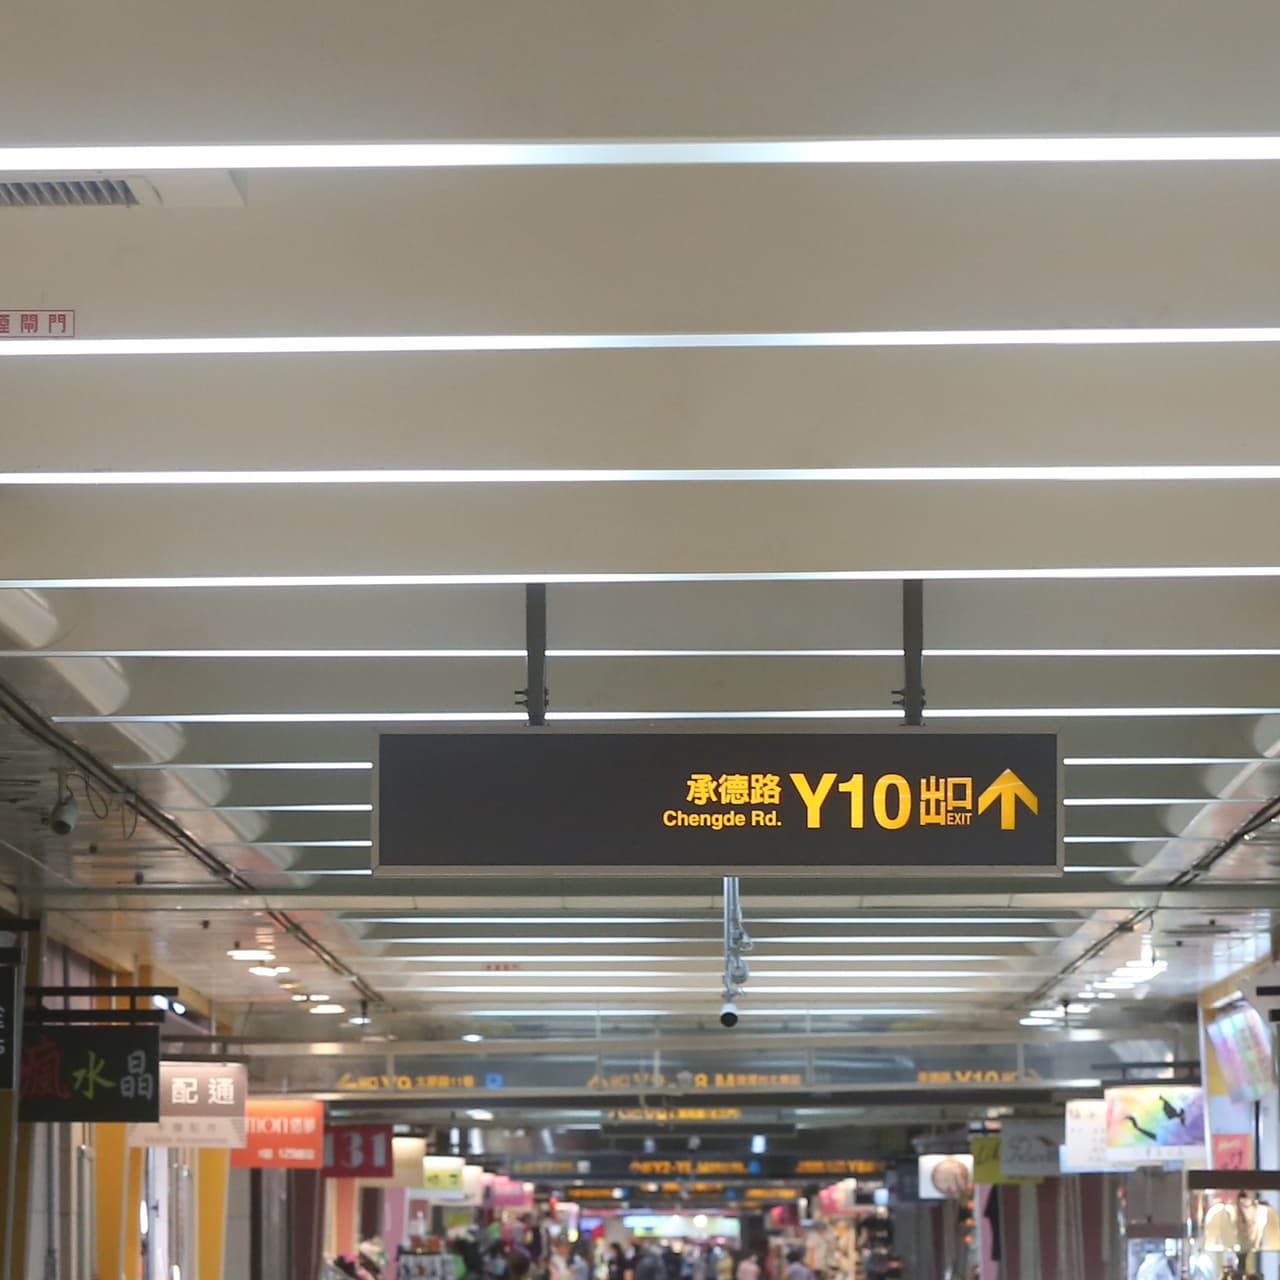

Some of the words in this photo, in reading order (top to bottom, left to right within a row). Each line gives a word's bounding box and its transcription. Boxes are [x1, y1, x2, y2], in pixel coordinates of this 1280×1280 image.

[686, 773, 783, 805] 承德路
[789, 772, 912, 831] Y10
[919, 775, 972, 827] 出口
[662, 810, 746, 831] Chengde
[750, 810, 782, 828] Rd.
[946, 813, 972, 825] EXIT
[171, 1077, 235, 1104] 配通
